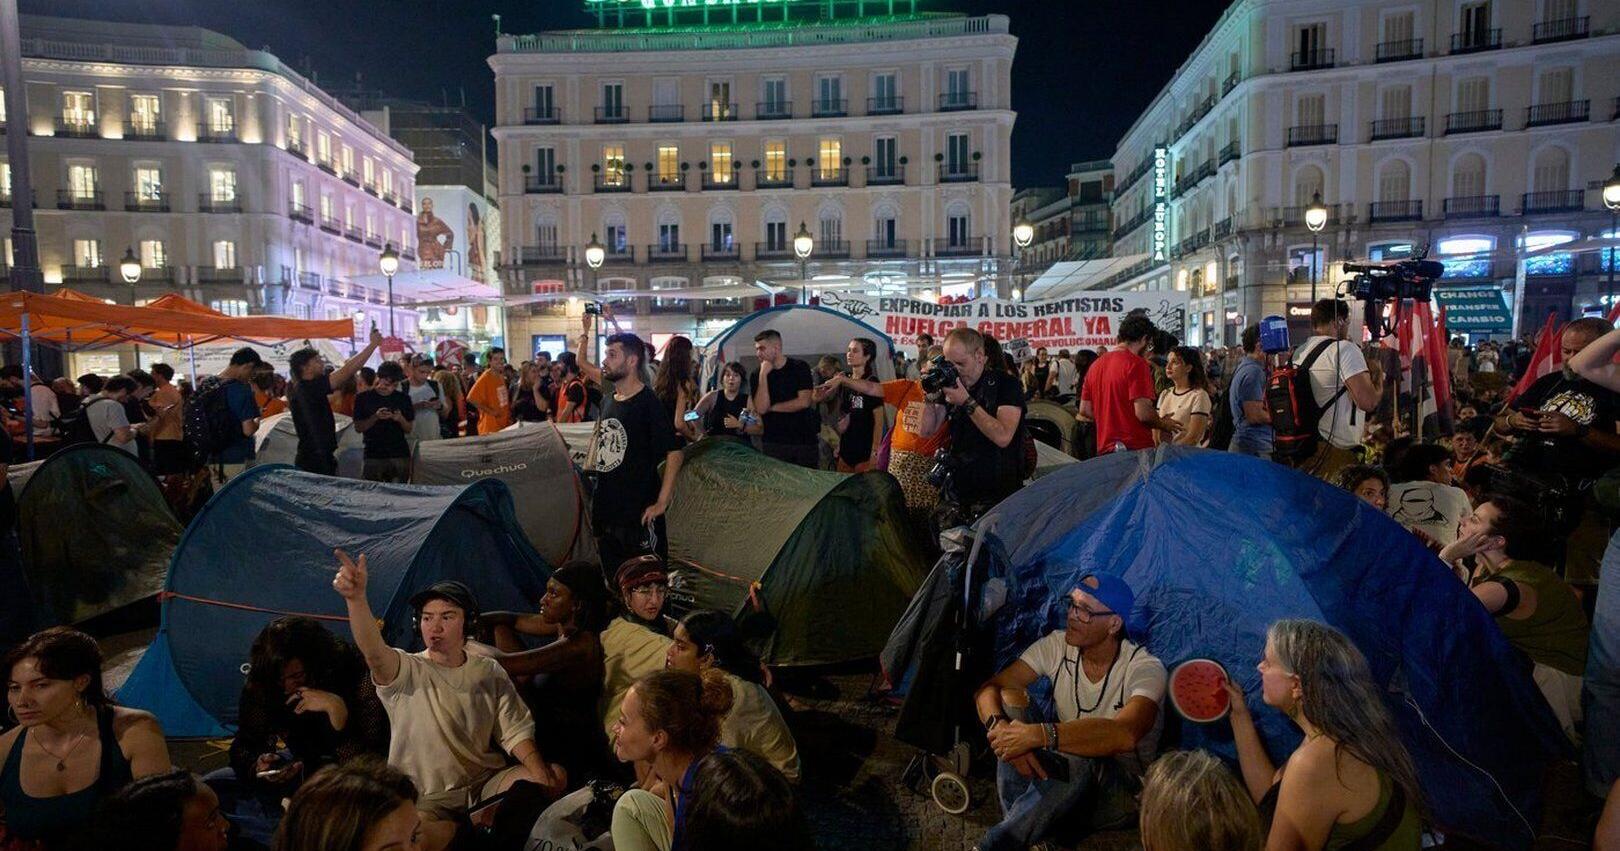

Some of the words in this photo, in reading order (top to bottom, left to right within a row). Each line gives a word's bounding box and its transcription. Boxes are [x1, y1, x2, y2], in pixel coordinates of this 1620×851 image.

[1154, 148, 1166, 197] HOTEL
[1154, 202, 1165, 260] EUROPA
[1439, 290, 1497, 299] CHANGE
[879, 298, 972, 317] EXPROPIAR
[978, 302, 989, 317] A
[995, 303, 1028, 317] LOS
[1033, 297, 1124, 317] RENTISTAS
[977, 316, 1076, 341] GENERAL
[1083, 315, 1111, 335] YA
[1447, 315, 1506, 323] CAMBIO
[460, 463, 528, 478] Quechua
